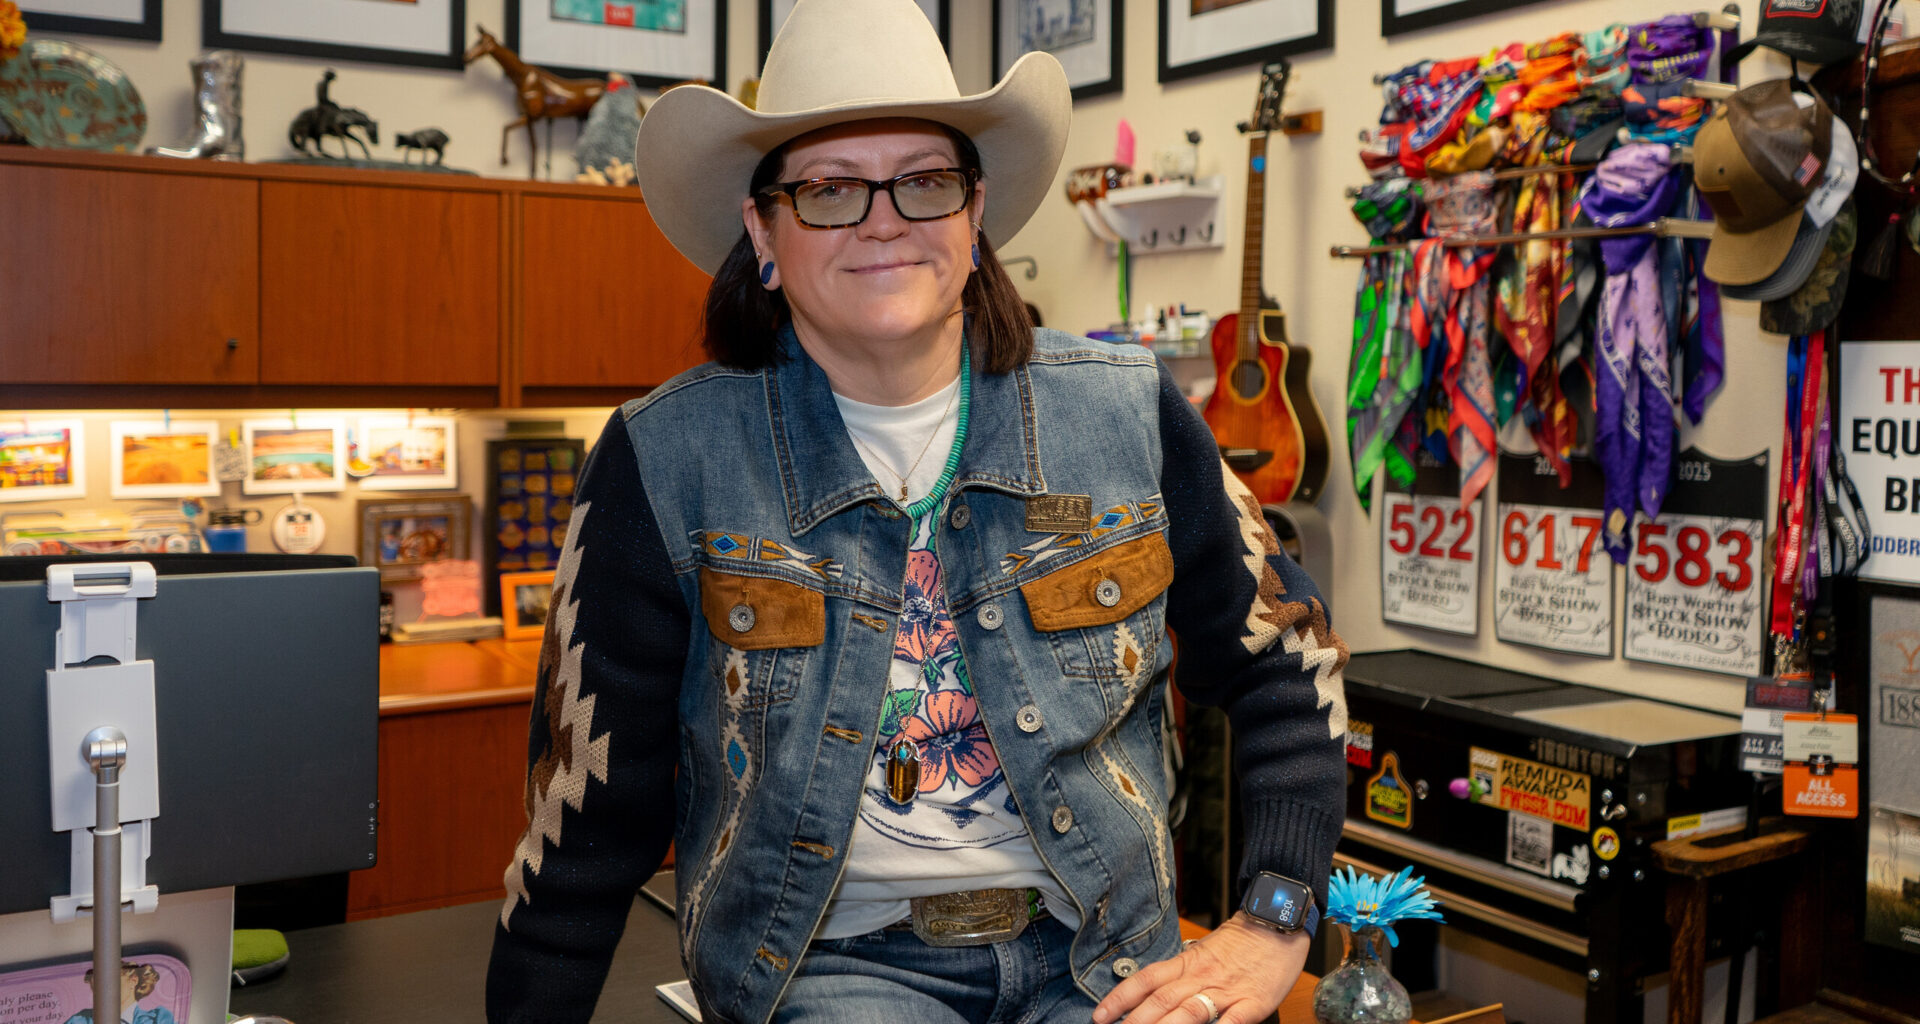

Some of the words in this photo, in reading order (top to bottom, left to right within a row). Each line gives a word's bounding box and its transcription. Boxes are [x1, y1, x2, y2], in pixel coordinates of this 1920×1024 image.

[1879, 367, 1920, 403] TH
[1852, 417, 1920, 459] EQU
[1389, 503, 1475, 562] 522
[1502, 510, 1603, 574] 617
[1634, 522, 1753, 592] 583
[1549, 593, 1601, 613] SHOW
[1683, 594, 1736, 612] WORTH
[1632, 603, 1690, 623] STOCK
[1694, 611, 1750, 631] SHOW
[1656, 621, 1720, 646] RODEO
[1537, 737, 1616, 780] IRONTON
[1501, 759, 1588, 793] REMUDA
[1501, 776, 1568, 802] AWARD
[1807, 778, 1835, 792] ALL
[1500, 786, 1588, 829] FWSSR.COM
[1795, 791, 1848, 808] ACCESS
[1279, 899, 1294, 922] 10:58
[933, 921, 957, 930] AMY
[17, 1003, 36, 1015] per
[18, 992, 53, 1004] please
